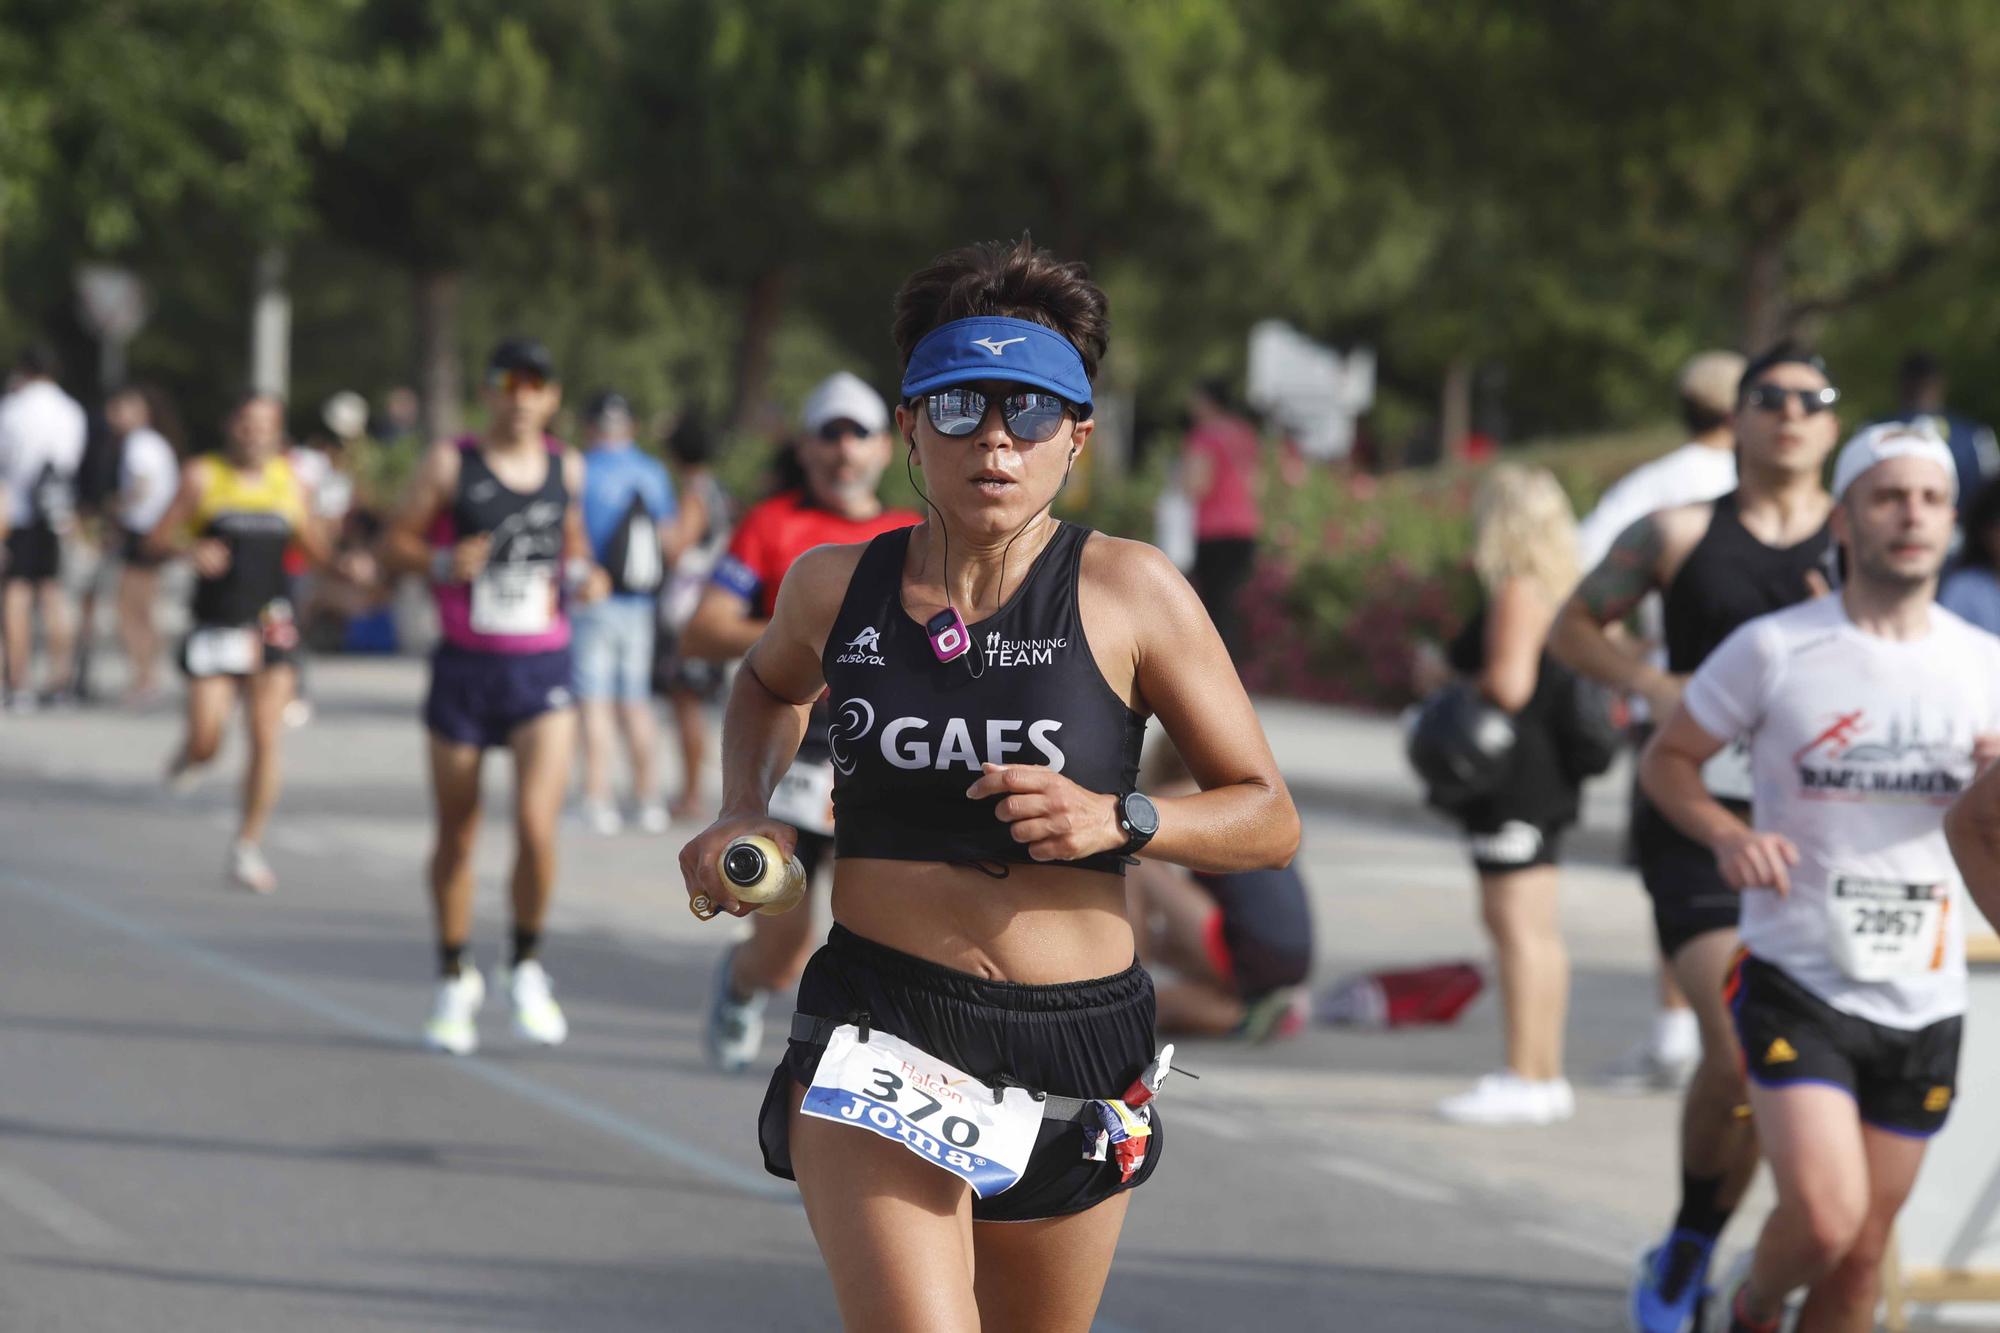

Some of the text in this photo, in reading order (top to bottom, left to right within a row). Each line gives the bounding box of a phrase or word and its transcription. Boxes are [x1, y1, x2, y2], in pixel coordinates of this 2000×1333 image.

[985, 648, 1052, 667] TEAM
[1002, 637, 1067, 651] RUNNING
[1855, 907, 1924, 937] 2057
[901, 1061, 963, 1104] Halcon
[862, 1067, 980, 1149] 370
